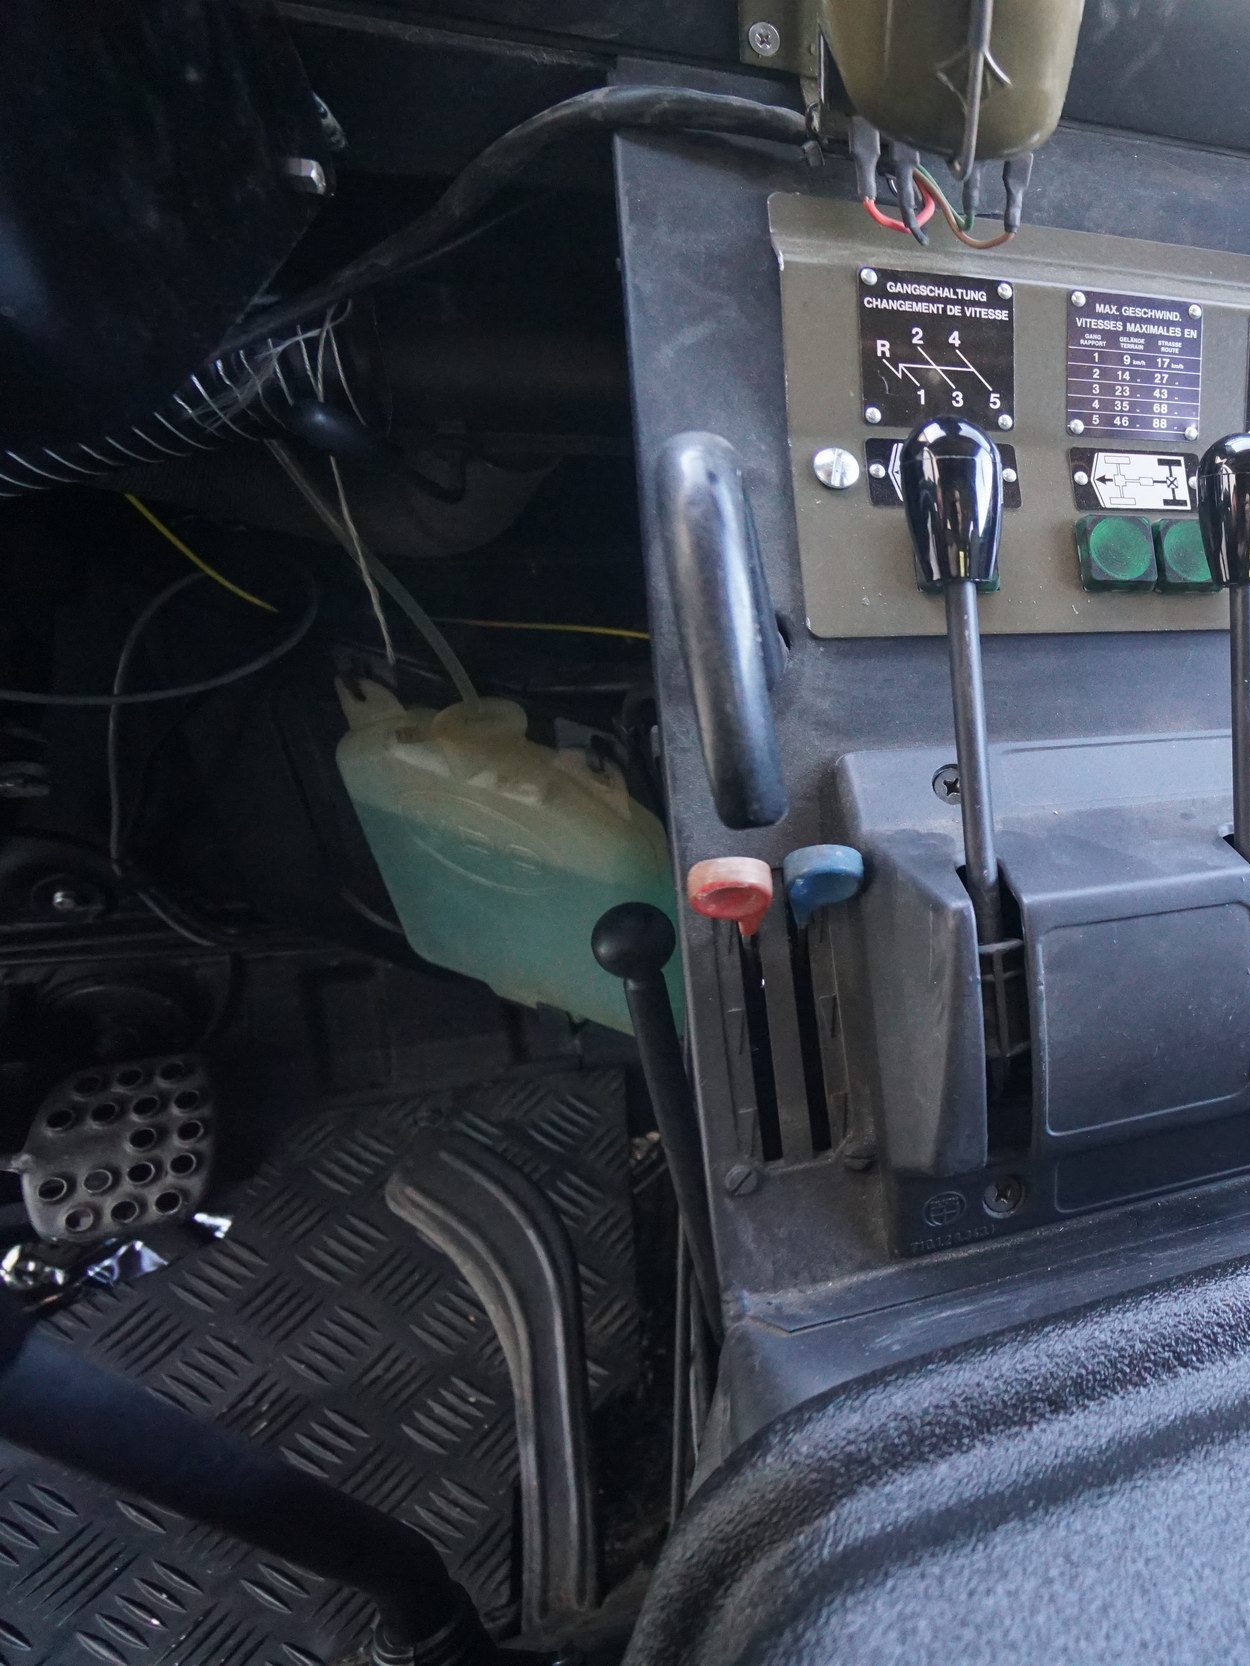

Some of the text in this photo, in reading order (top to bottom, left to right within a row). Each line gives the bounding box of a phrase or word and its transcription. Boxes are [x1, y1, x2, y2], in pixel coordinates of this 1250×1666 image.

[887, 282, 987, 301] GANGSCHALTUNG
[864, 297, 1009, 320] CHANGEMENT DE VITESSE
[1096, 304, 1182, 321] MAX. GESCHWIND.
[1076, 318, 1197, 338] VITESSES MAXIMALES EN
[912, 327, 961, 347] 2 4
[876, 340, 890, 357] R
[1093, 353, 1098, 362] 1
[1124, 355, 1130, 364] 9
[1156, 358, 1169, 368] 17
[1093, 369, 1168, 383] 2 14 27
[917, 389, 1000, 409] 1 3 5
[1093, 384, 1168, 398] 3 23 43
[1092, 400, 1167, 414] 4 35 68
[1092, 415, 1166, 428] 5 46 88
